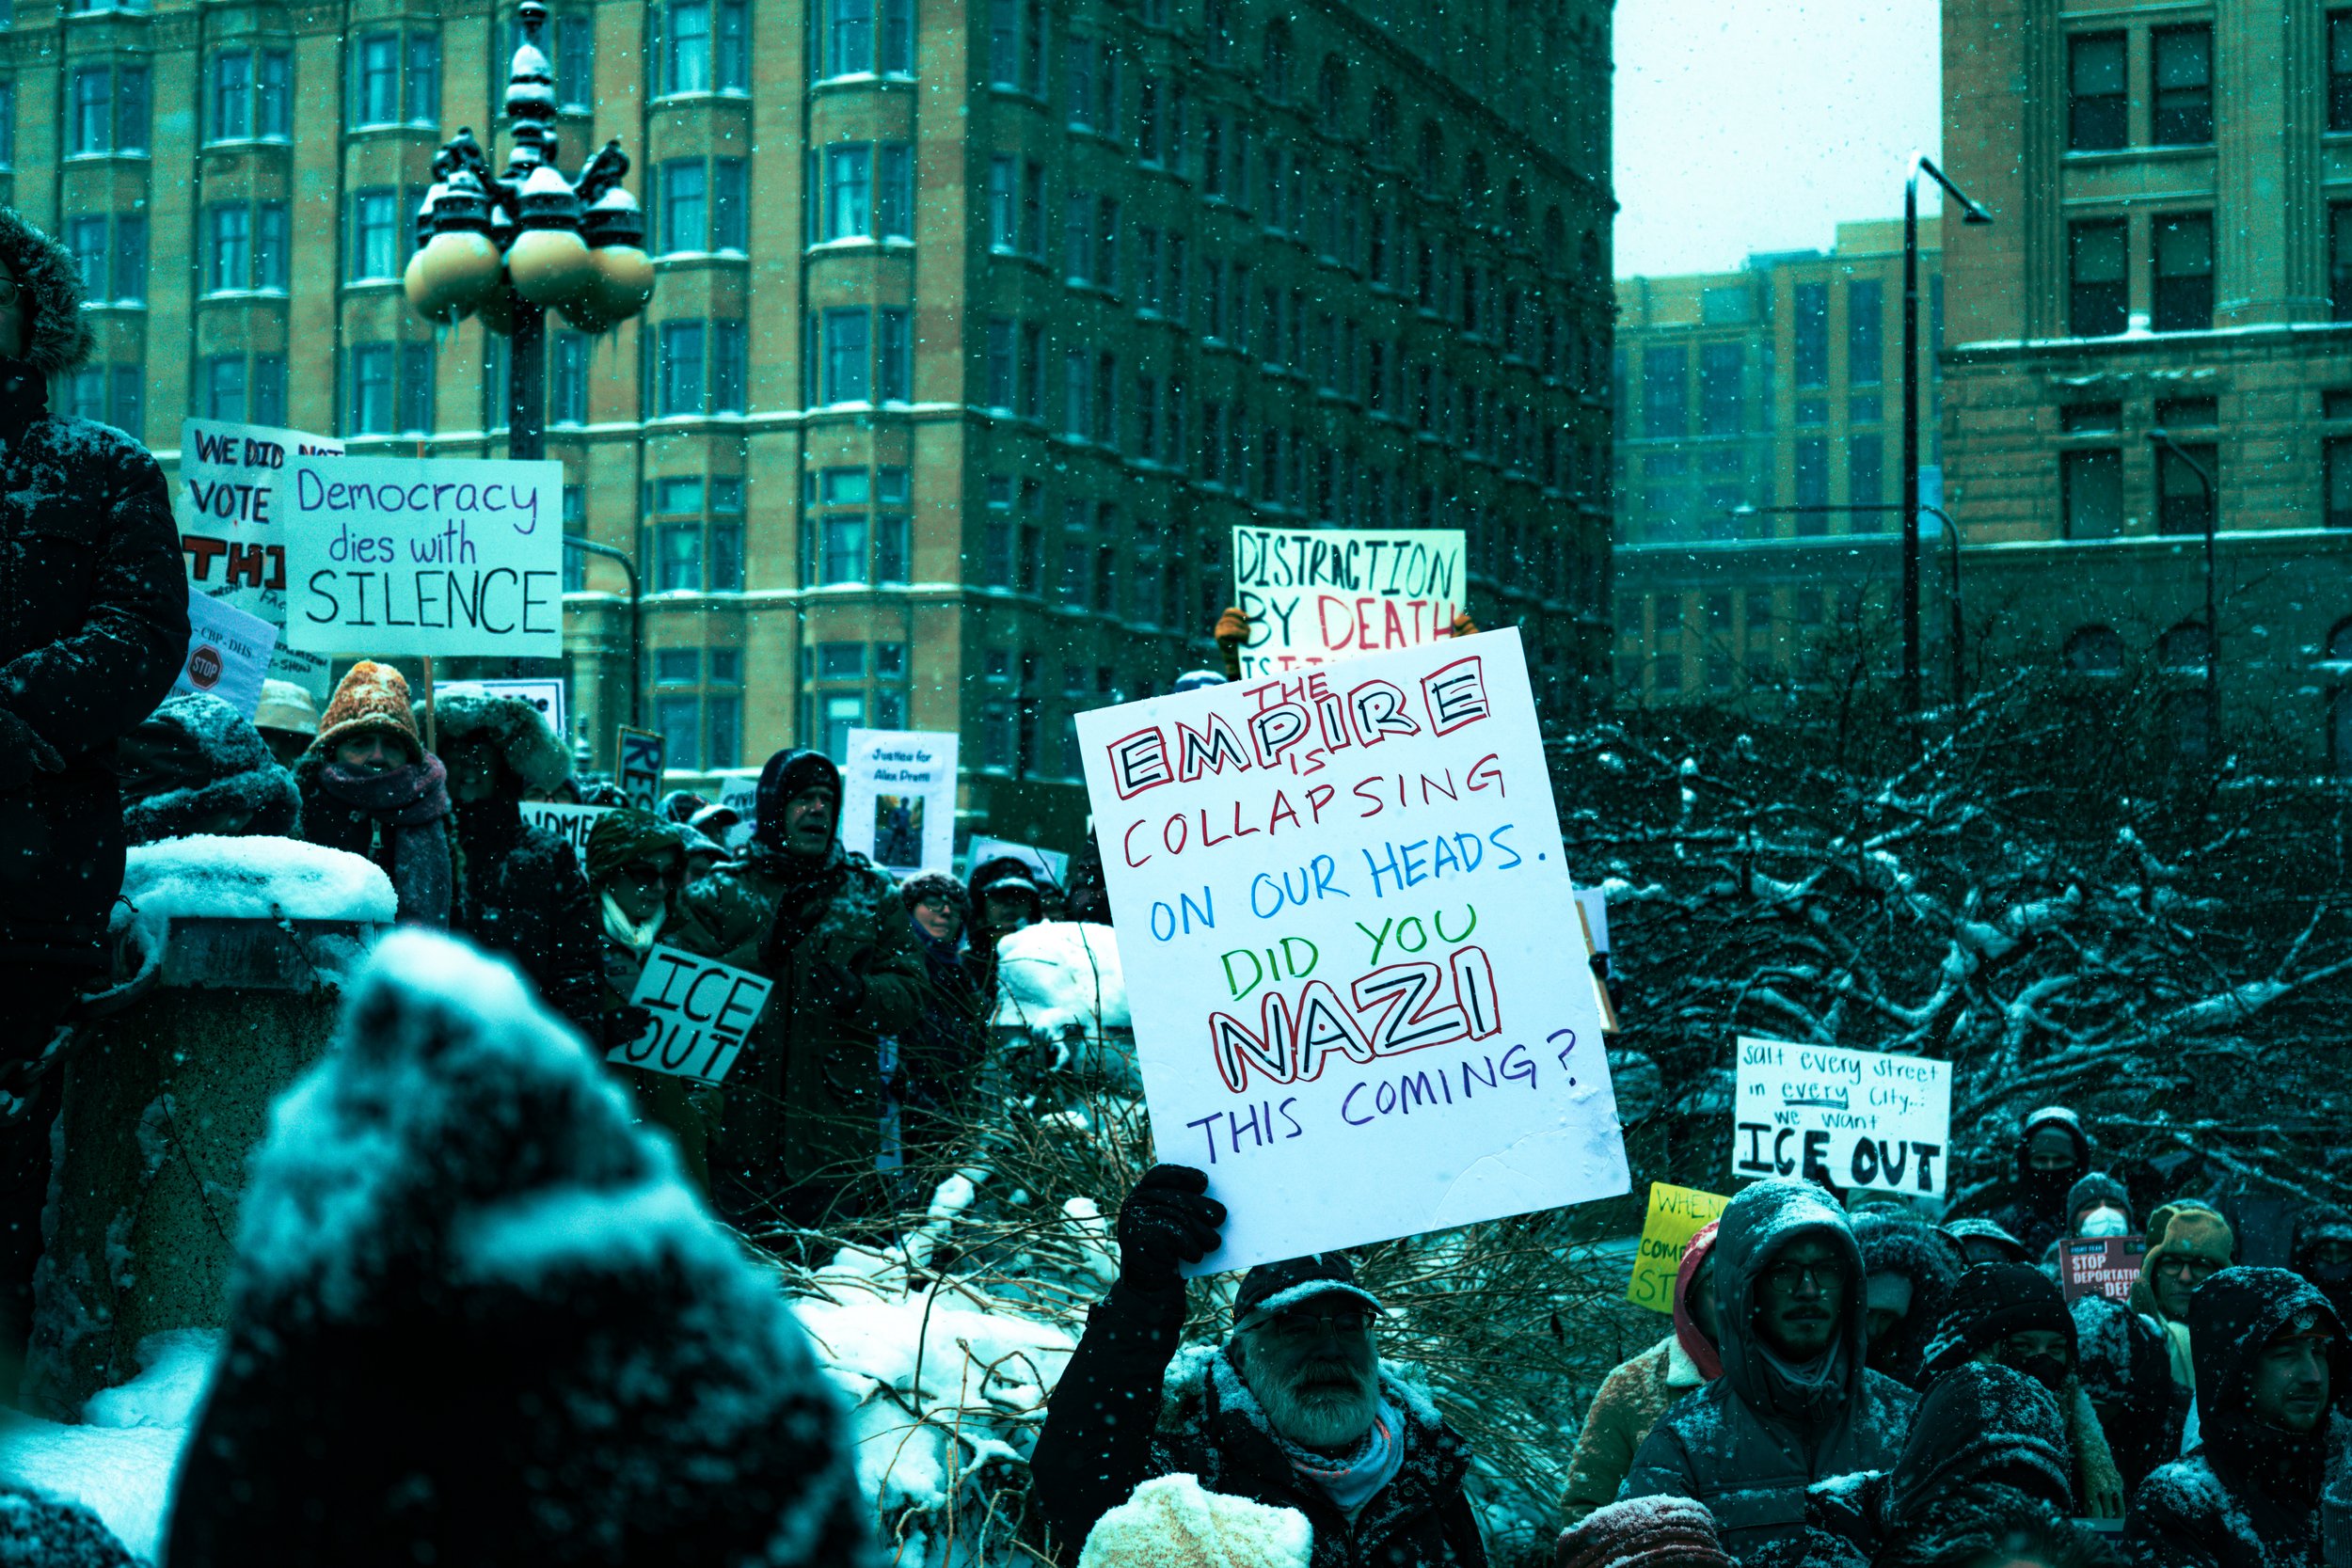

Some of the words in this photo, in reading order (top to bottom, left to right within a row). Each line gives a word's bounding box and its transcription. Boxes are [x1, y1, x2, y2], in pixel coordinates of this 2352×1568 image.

[195, 429, 239, 465] WE
[245, 436, 285, 469] DID
[189, 478, 272, 524] VOTE
[297, 468, 537, 535] Democracy
[329, 523, 394, 562] dies
[410, 518, 476, 564] with
[1238, 530, 1458, 599] DISTRACTION
[306, 567, 558, 634] SILENCE
[1239, 591, 1300, 648] BY
[1317, 594, 1455, 651] DEATH
[192, 656, 218, 678] STOP
[200, 626, 224, 644] CBP
[229, 638, 254, 658] DHS
[1243, 672, 1328, 711] THE
[1107, 656, 1489, 800] EMPIRE
[1291, 748, 1327, 776] IS
[1124, 753, 1505, 867] COLLAPSING
[1151, 885, 1215, 942] ON
[1251, 854, 1350, 918] OUR
[1363, 824, 1546, 897] HEADS.
[1221, 938, 1318, 1001] DID
[1356, 903, 1476, 965] YOU
[642, 953, 766, 1037] ICE
[1210, 945, 1502, 1092] NAZI
[626, 1016, 739, 1077] OUT
[1801, 1051, 1862, 1085] every
[1750, 1082, 1765, 1096] in
[1782, 1082, 1850, 1107] every
[1774, 1111, 1801, 1126] we
[1821, 1112, 1880, 1130] want
[1187, 1097, 1303, 1164] THIS
[1738, 1122, 1831, 1180] ICE
[1851, 1136, 1941, 1193] OUT
[1657, 1188, 1722, 1220] WHEN
[2072, 1253, 2107, 1272] STOP
[2104, 1280, 2135, 1297] DEF
